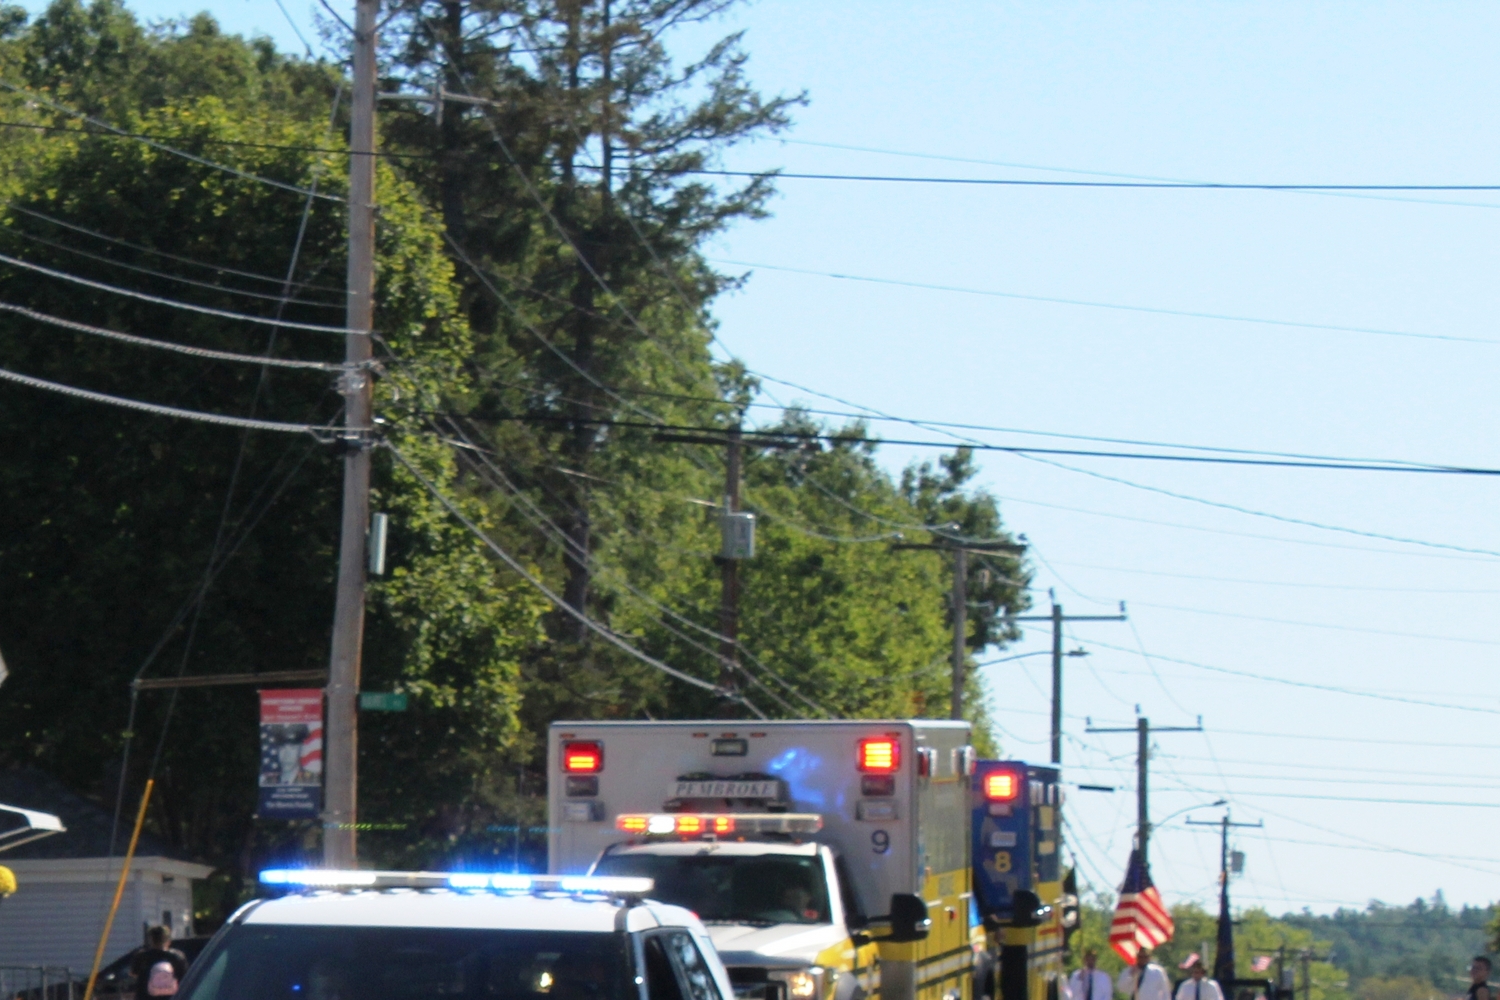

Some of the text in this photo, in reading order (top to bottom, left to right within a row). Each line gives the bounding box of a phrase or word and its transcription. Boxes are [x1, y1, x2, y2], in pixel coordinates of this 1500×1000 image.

[676, 782, 772, 796] PEMBROKE
[871, 829, 890, 854] 9
[994, 850, 1012, 873] 8
